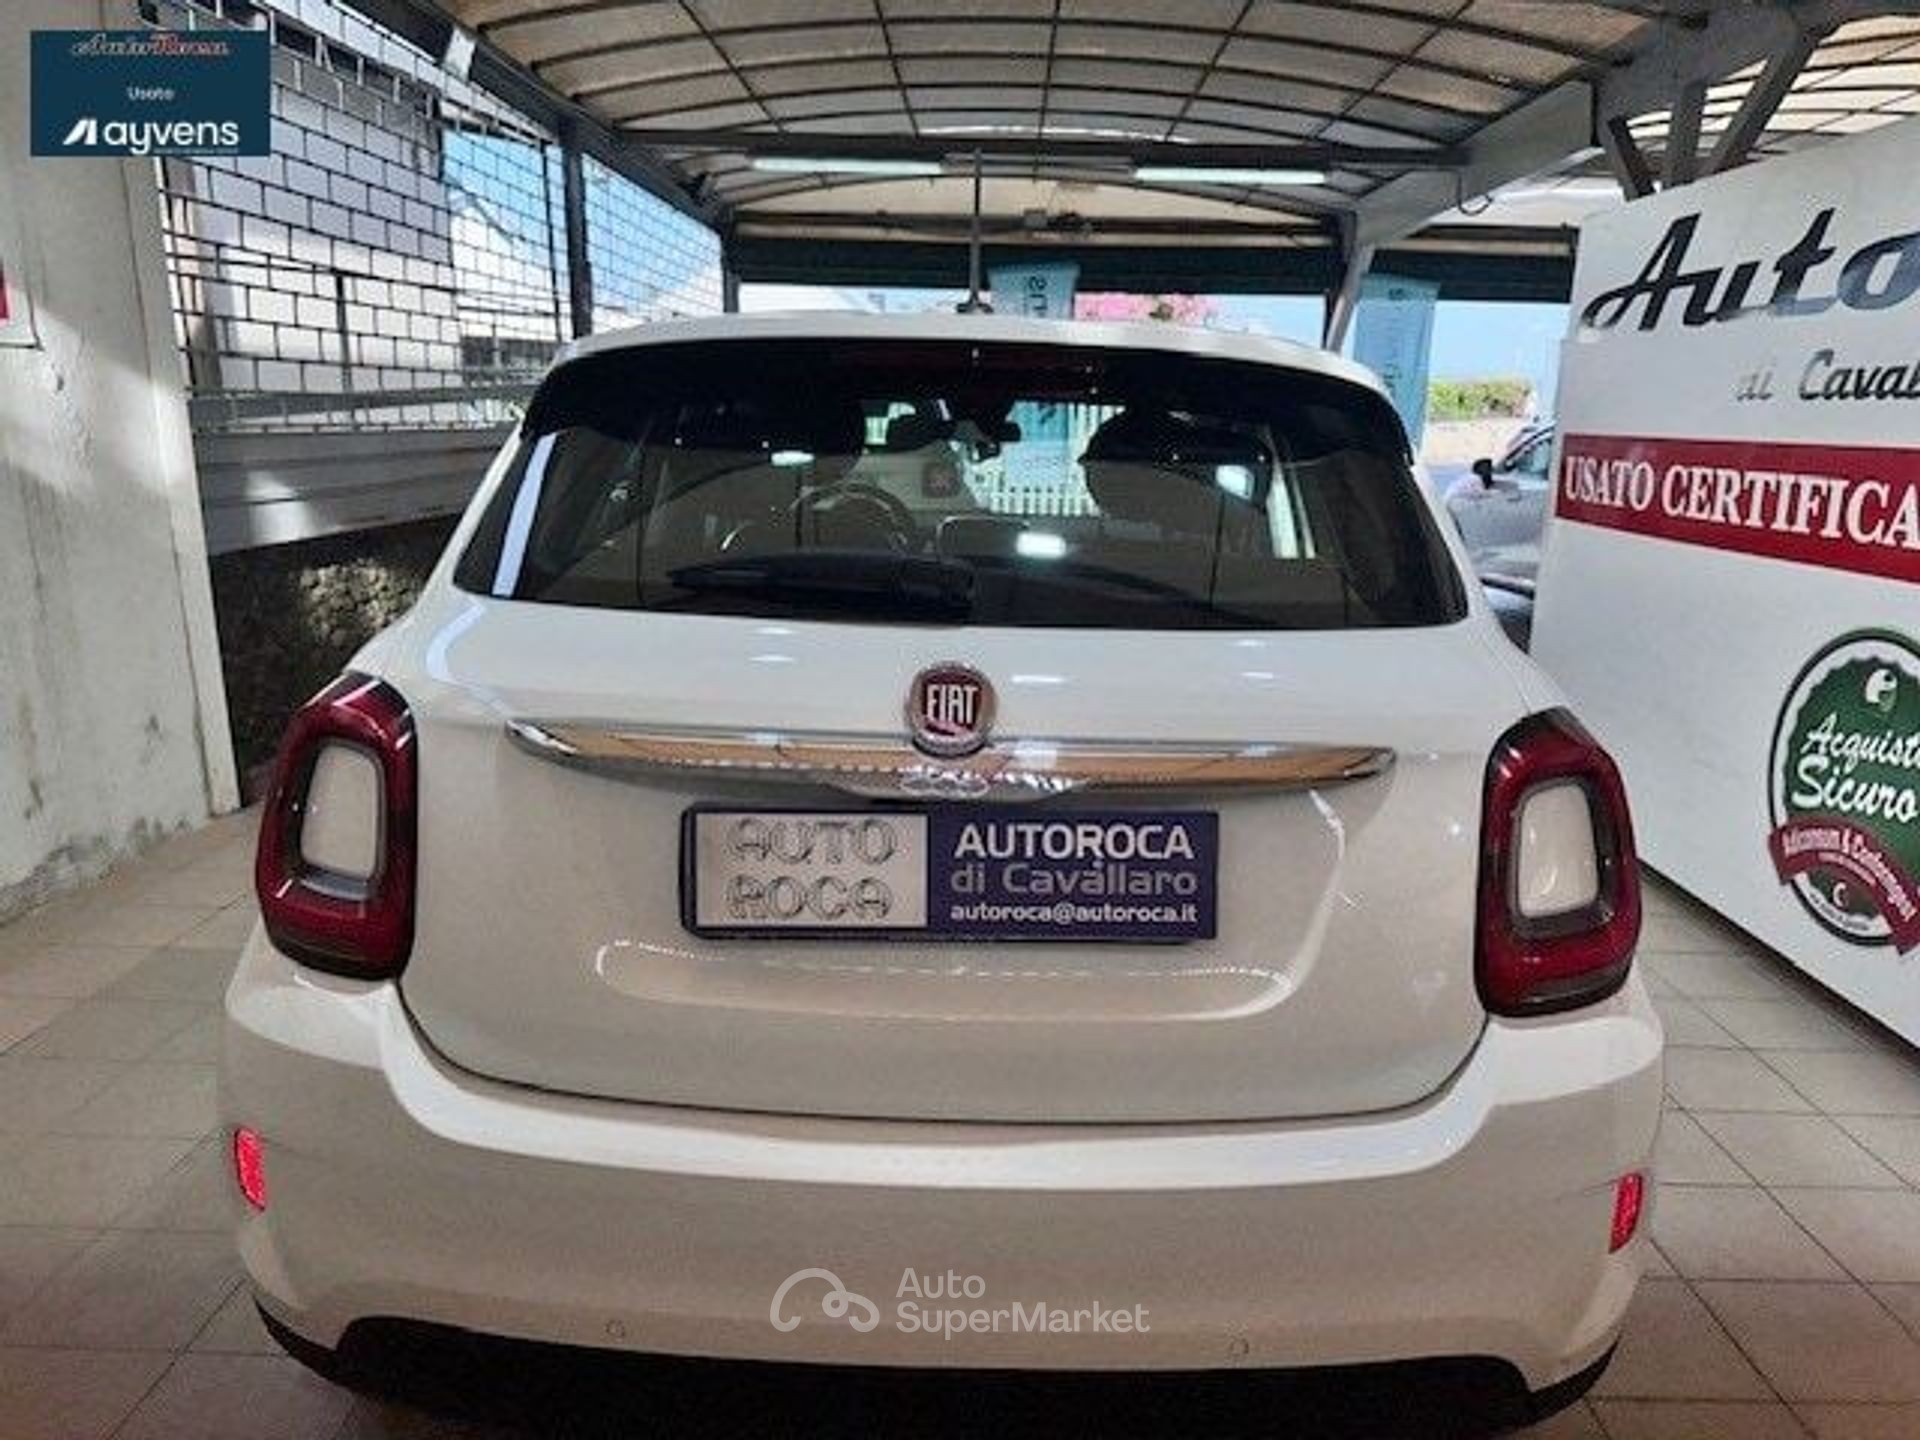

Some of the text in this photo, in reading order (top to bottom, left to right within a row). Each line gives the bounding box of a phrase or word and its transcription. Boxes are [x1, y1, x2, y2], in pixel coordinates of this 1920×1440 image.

[1581, 207, 1920, 331] Auto
[1565, 456, 1920, 551] USATO CERTIFICA
[926, 683, 979, 725] FIAT
[1800, 710, 1920, 775] Acquist
[1791, 753, 1919, 823] Sicuro
[726, 818, 898, 865] AUTO
[953, 823, 1195, 860] AUTOROCA
[726, 874, 893, 920] ROCA
[951, 863, 1198, 896] di Cavallaro
[950, 903, 1198, 925] autoroca@autoroca.it
